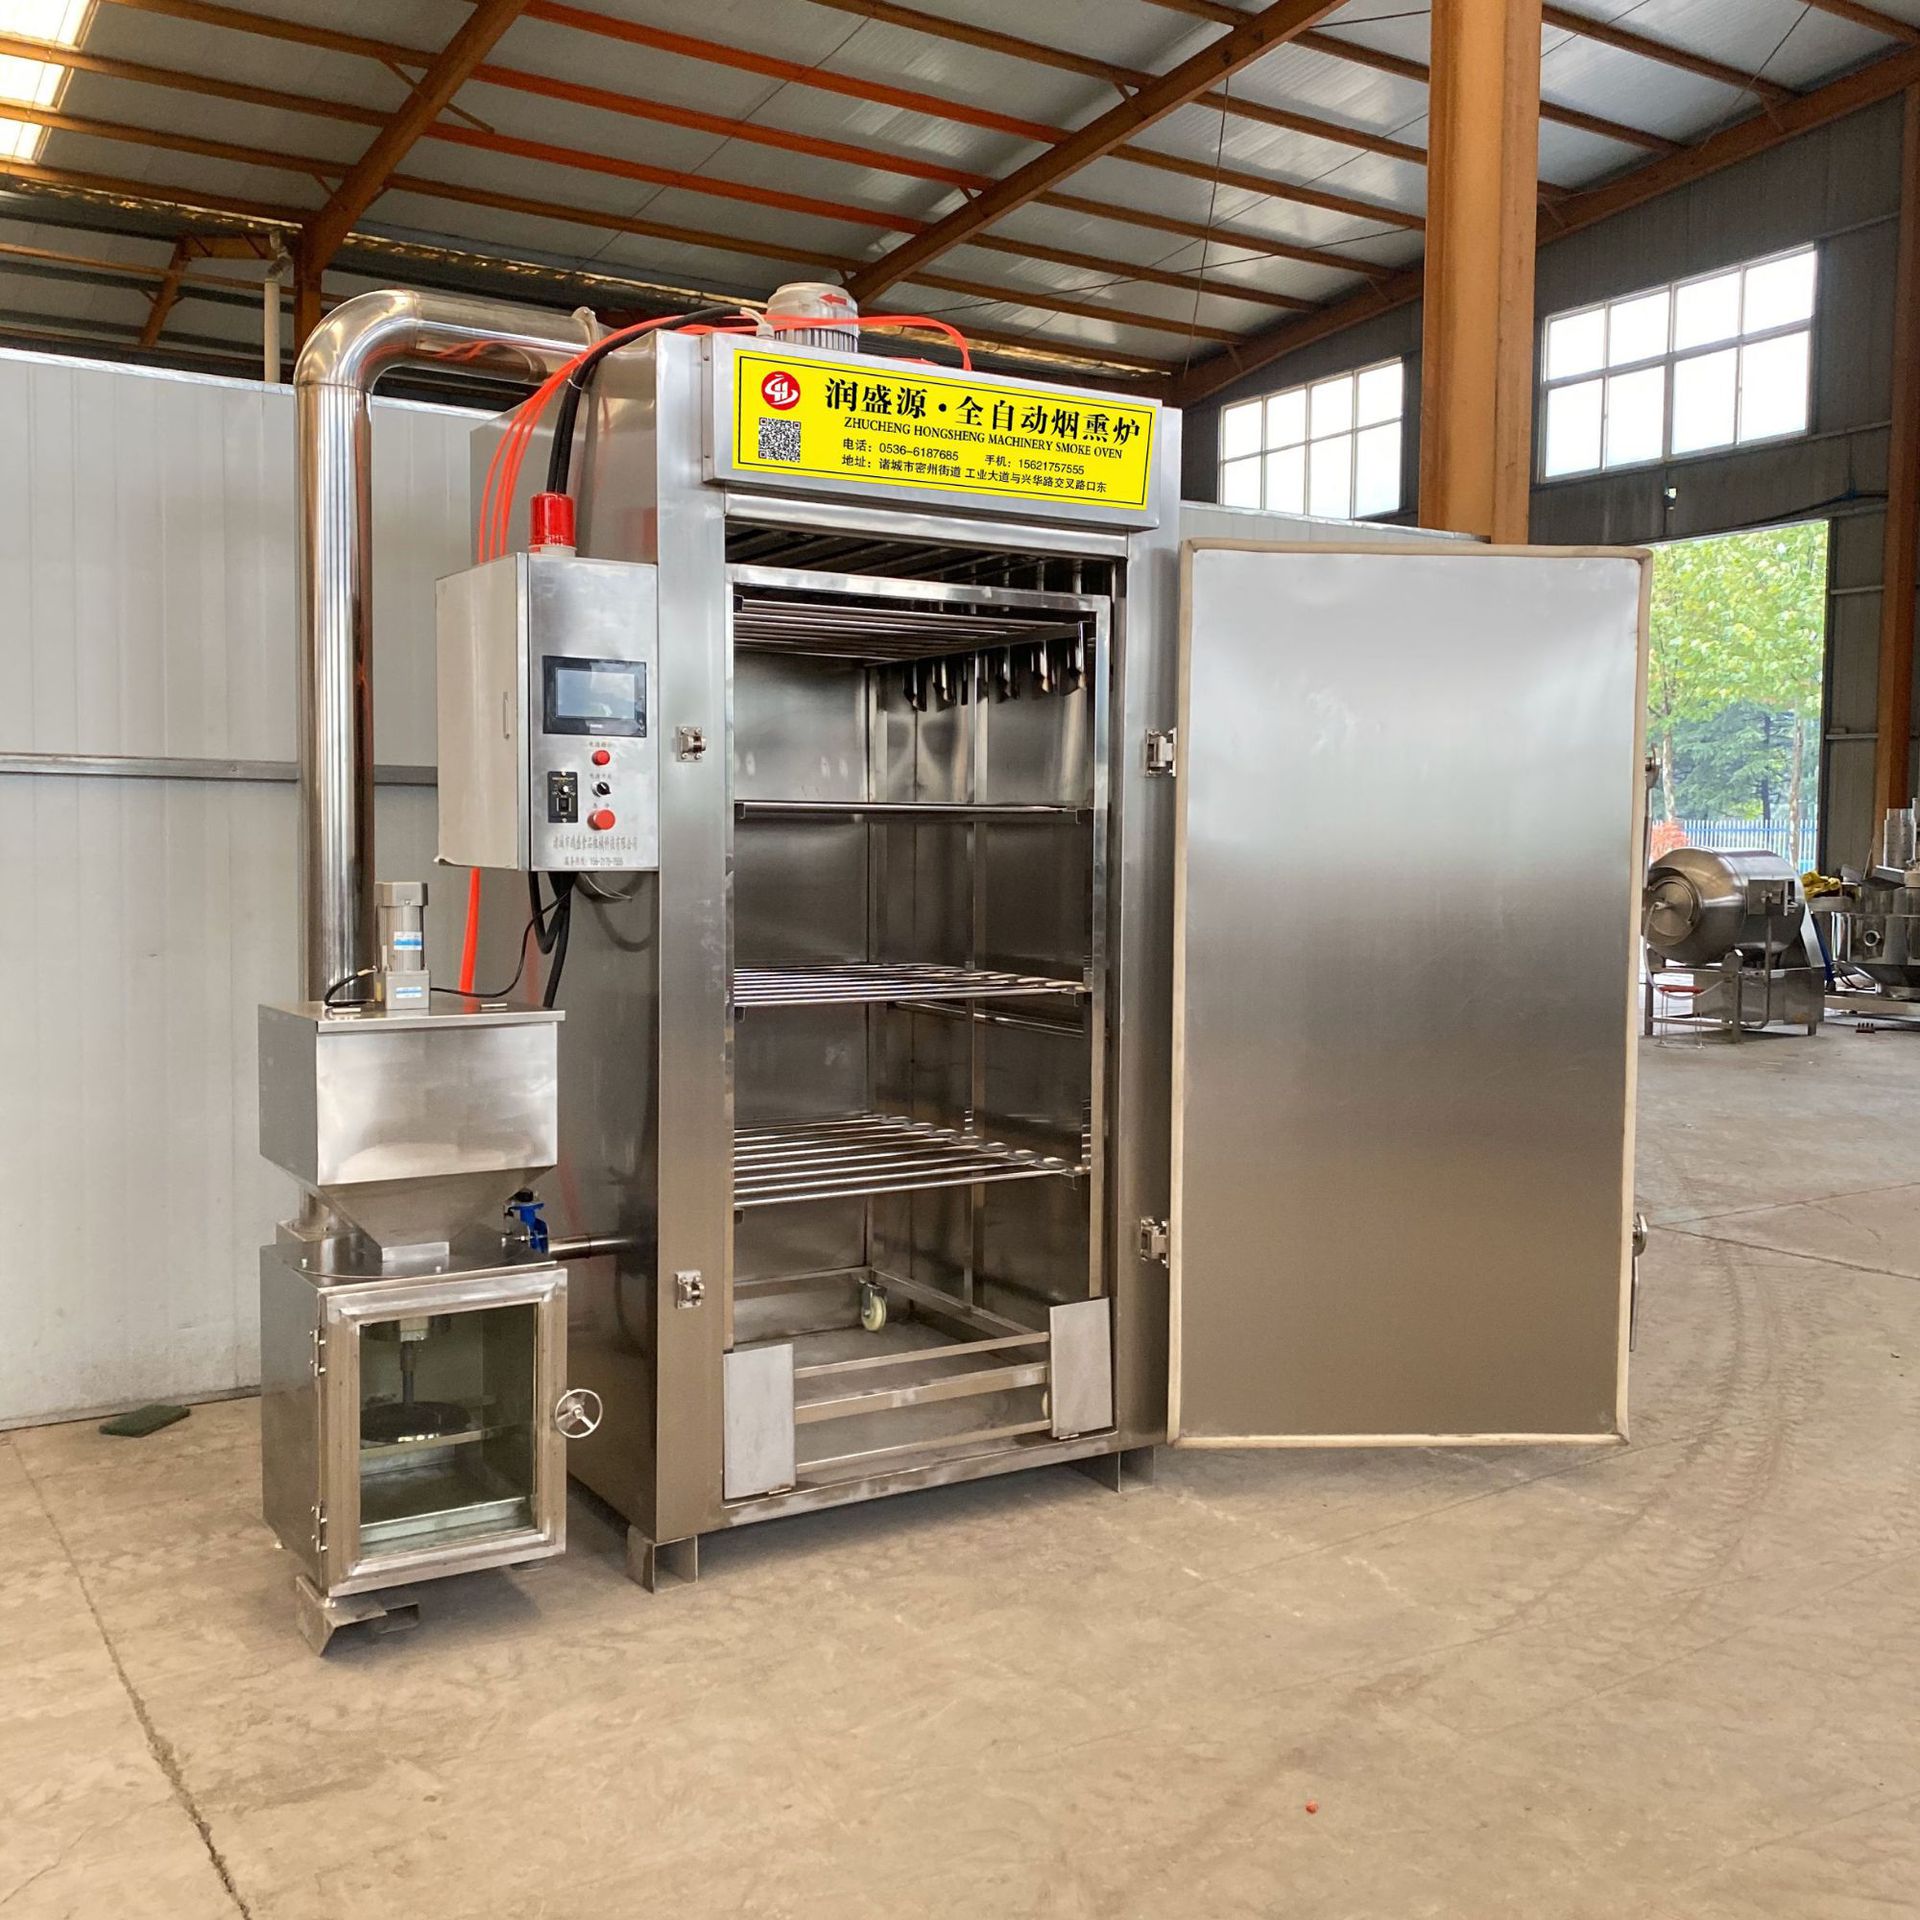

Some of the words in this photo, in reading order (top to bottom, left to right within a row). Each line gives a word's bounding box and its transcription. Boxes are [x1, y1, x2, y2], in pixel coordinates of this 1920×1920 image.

[844, 417, 911, 435] ZHUCHENG
[914, 425, 985, 443] HONGSHENG
[988, 434, 1053, 451] MACHINERY
[1056, 442, 1091, 456] SMOKE
[1094, 447, 1123, 459] OVEN
